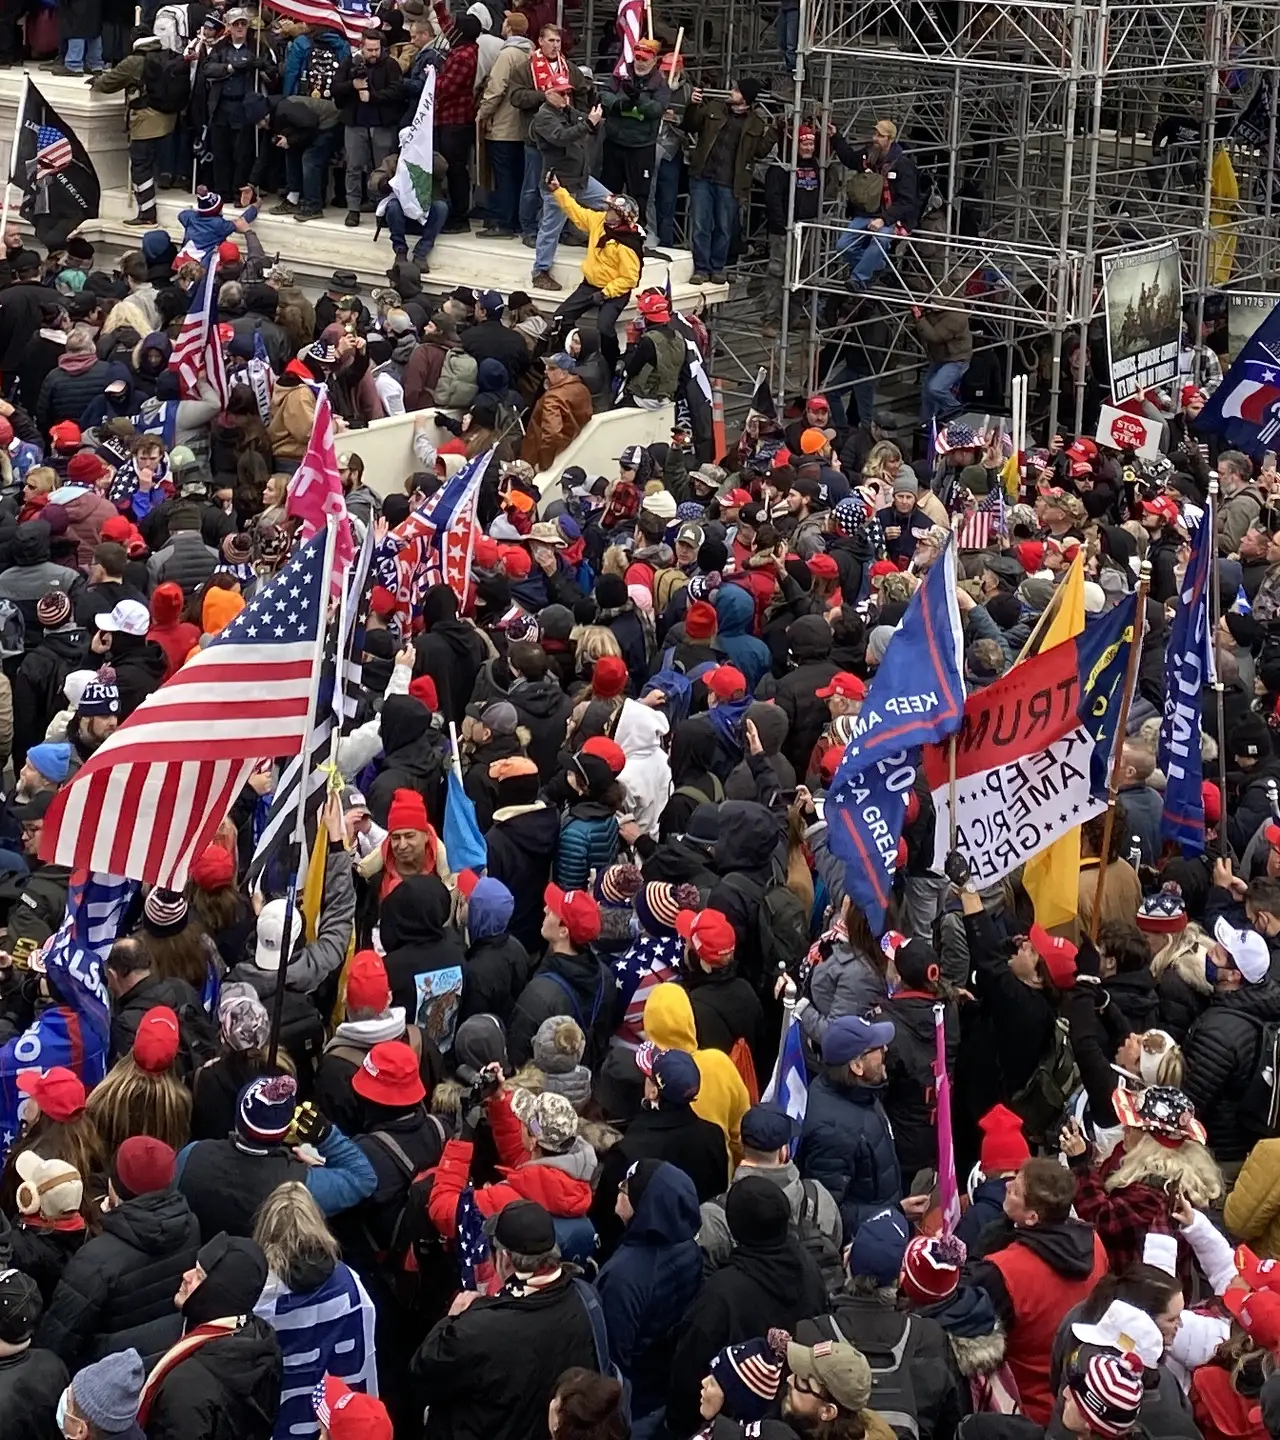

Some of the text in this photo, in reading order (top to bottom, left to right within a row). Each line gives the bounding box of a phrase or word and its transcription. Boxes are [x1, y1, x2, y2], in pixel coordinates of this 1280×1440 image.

[1231, 296, 1242, 306] IN
[1116, 419, 1143, 434] STOP
[1112, 431, 1143, 448] STEAL
